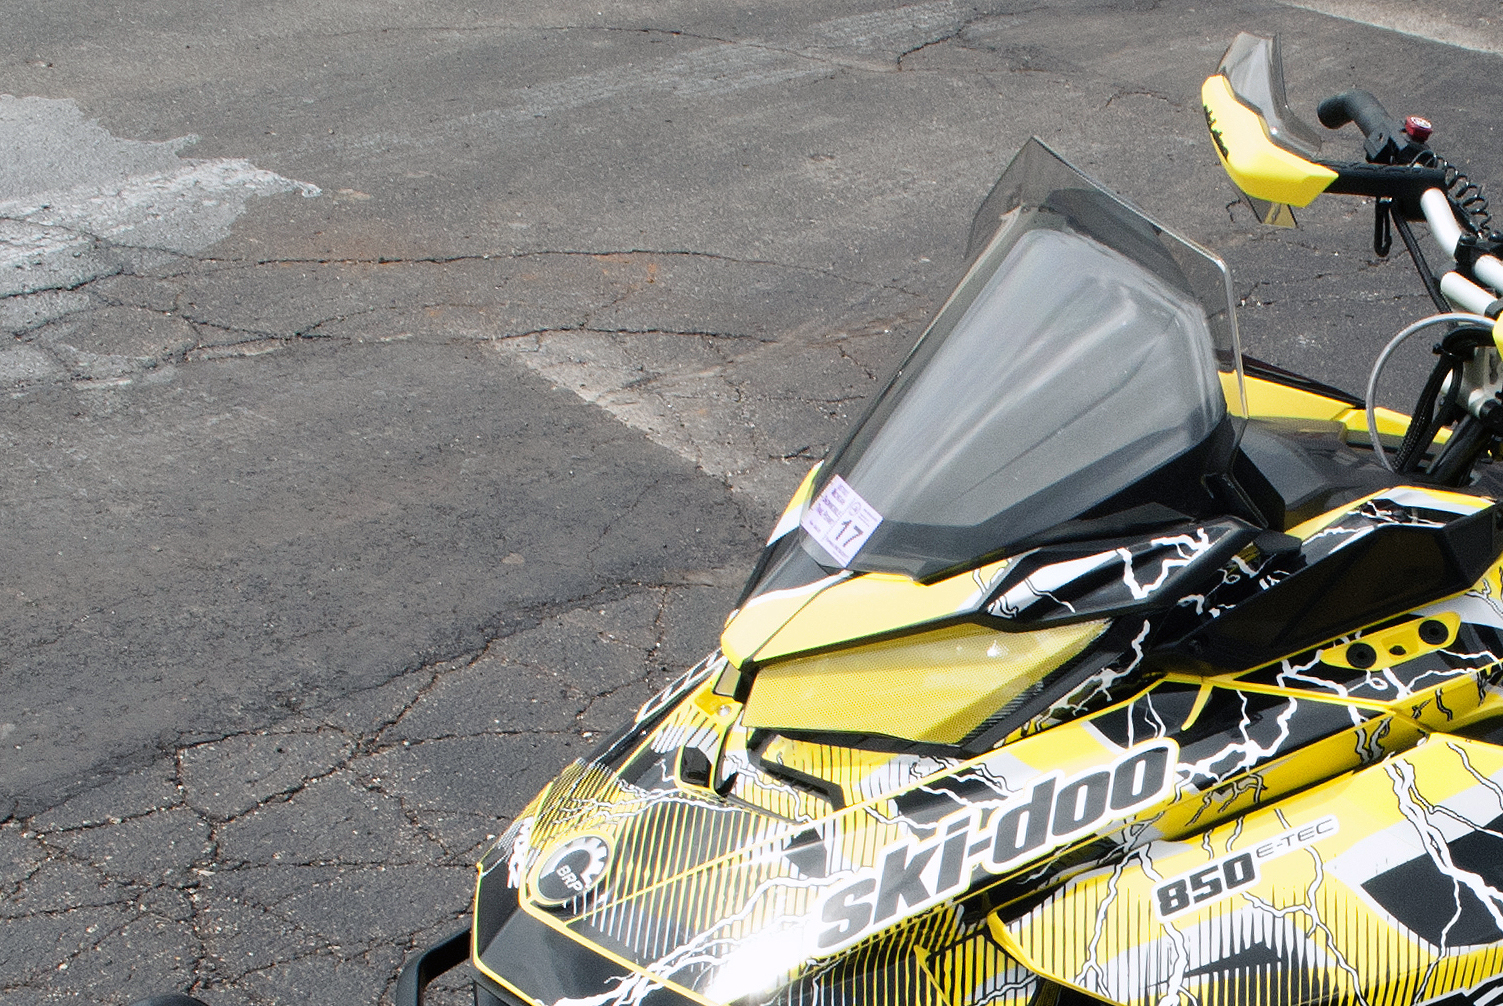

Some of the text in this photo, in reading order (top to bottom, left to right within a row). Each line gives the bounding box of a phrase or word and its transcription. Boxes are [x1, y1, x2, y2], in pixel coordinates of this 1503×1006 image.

[836, 519, 864, 548] 17
[556, 864, 585, 892] BRP
[816, 745, 1170, 950] ski-doo
[1156, 818, 1335, 917] 850 E-TEC
